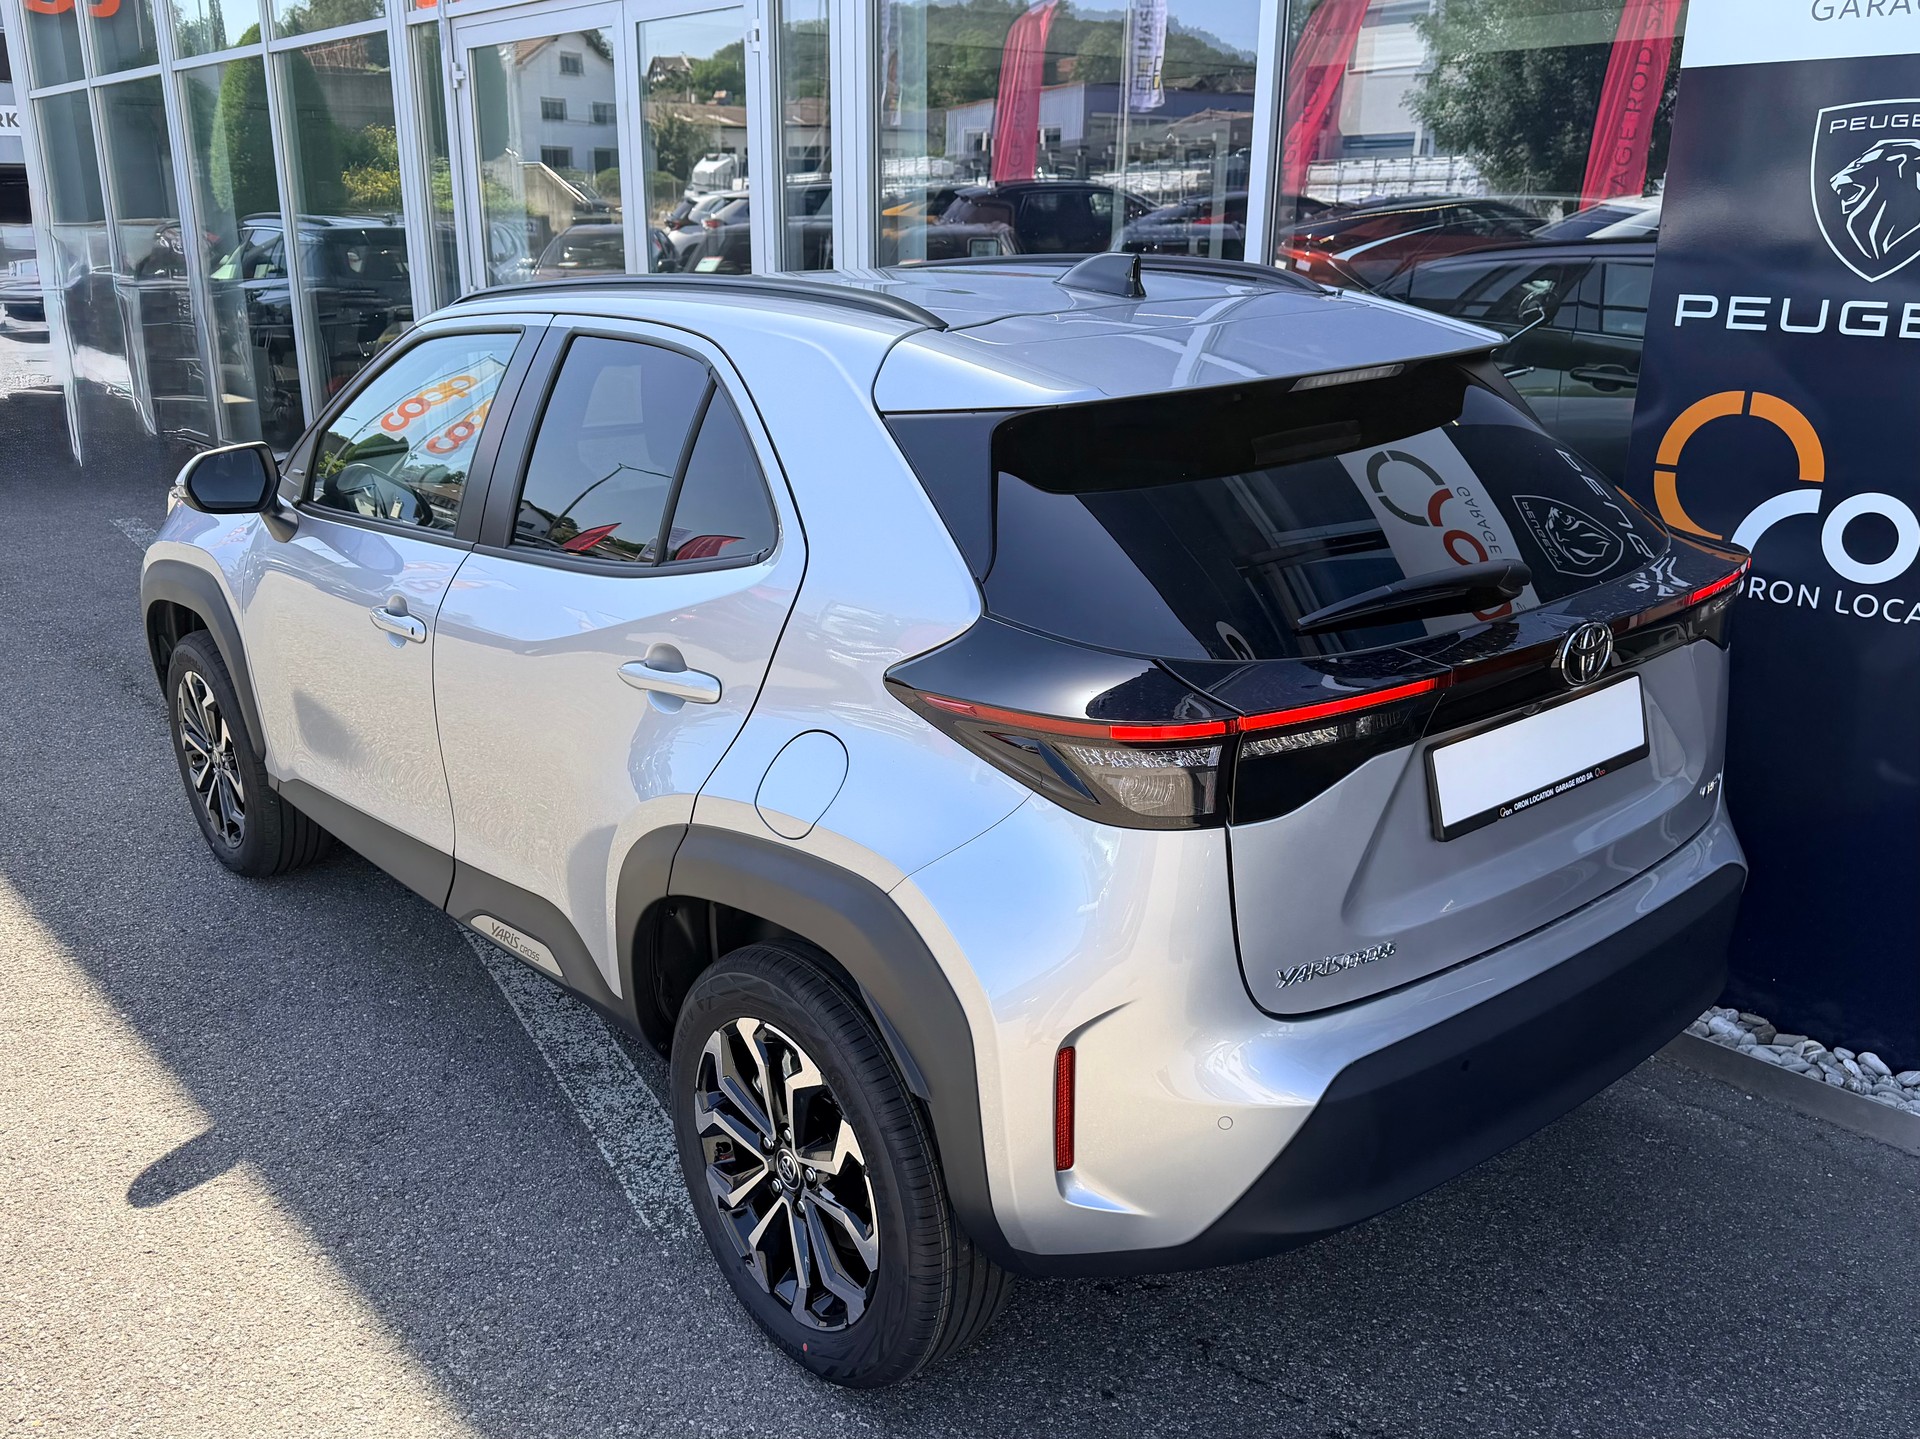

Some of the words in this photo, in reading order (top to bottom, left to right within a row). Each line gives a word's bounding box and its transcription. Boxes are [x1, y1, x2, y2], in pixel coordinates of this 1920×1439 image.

[1811, 0, 1920, 21] GARA
[1611, 127, 1638, 195] AGE
[1626, 46, 1652, 114] ROD
[381, 375, 478, 432] coop
[1736, 575, 1821, 609] RON
[1513, 799, 1529, 811] ORON
[1529, 788, 1554, 805] LOCATION
[1555, 778, 1576, 793] GARAGE
[1586, 771, 1594, 781] SA
[519, 944, 541, 962] CROSS
